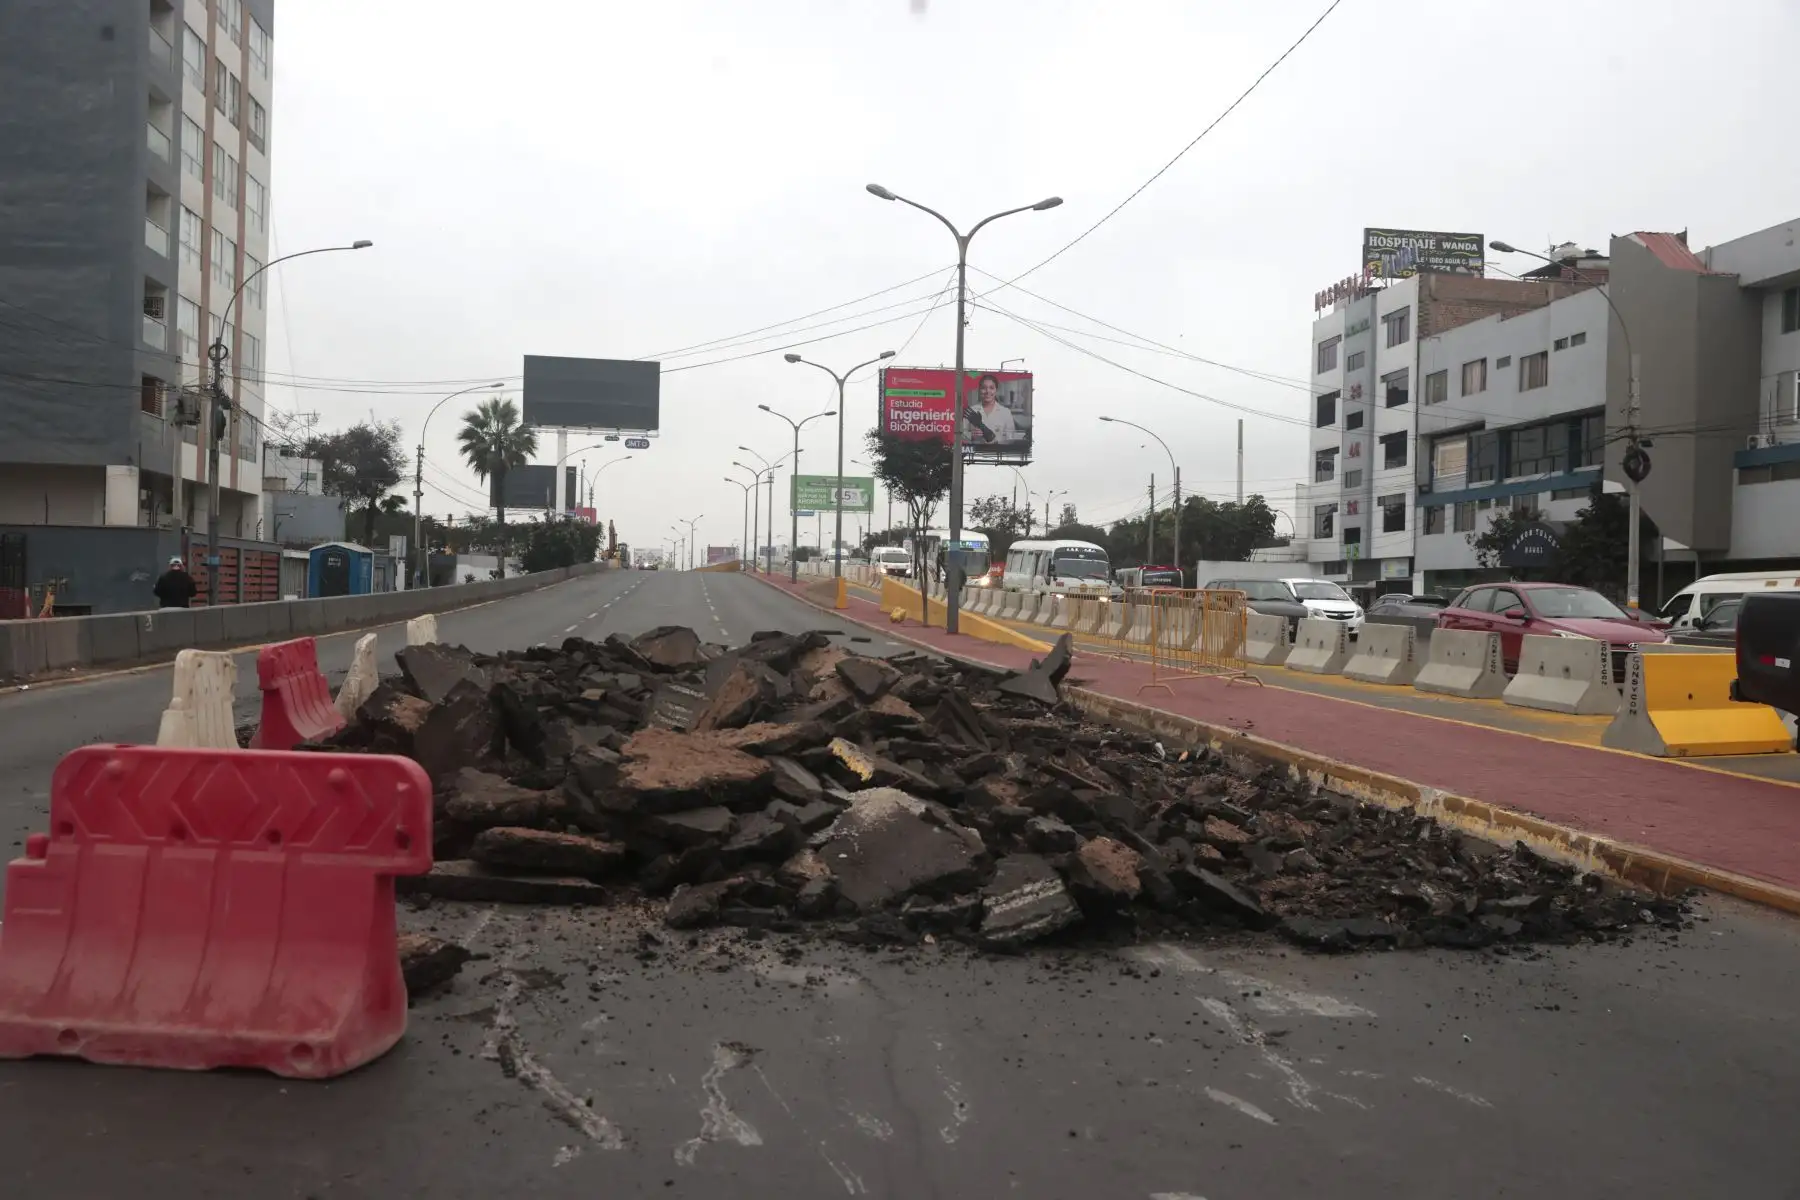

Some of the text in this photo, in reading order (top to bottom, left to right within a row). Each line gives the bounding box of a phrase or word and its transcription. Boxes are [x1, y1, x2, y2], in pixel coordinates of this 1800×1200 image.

[1368, 235, 1479, 252] HOSPEDAJE WANDA
[890, 399, 923, 409] Estudia
[889, 421, 952, 433] Biomédica
[1600, 640, 1609, 686] CONSYCON
[1629, 656, 1640, 715] CONSYCON
